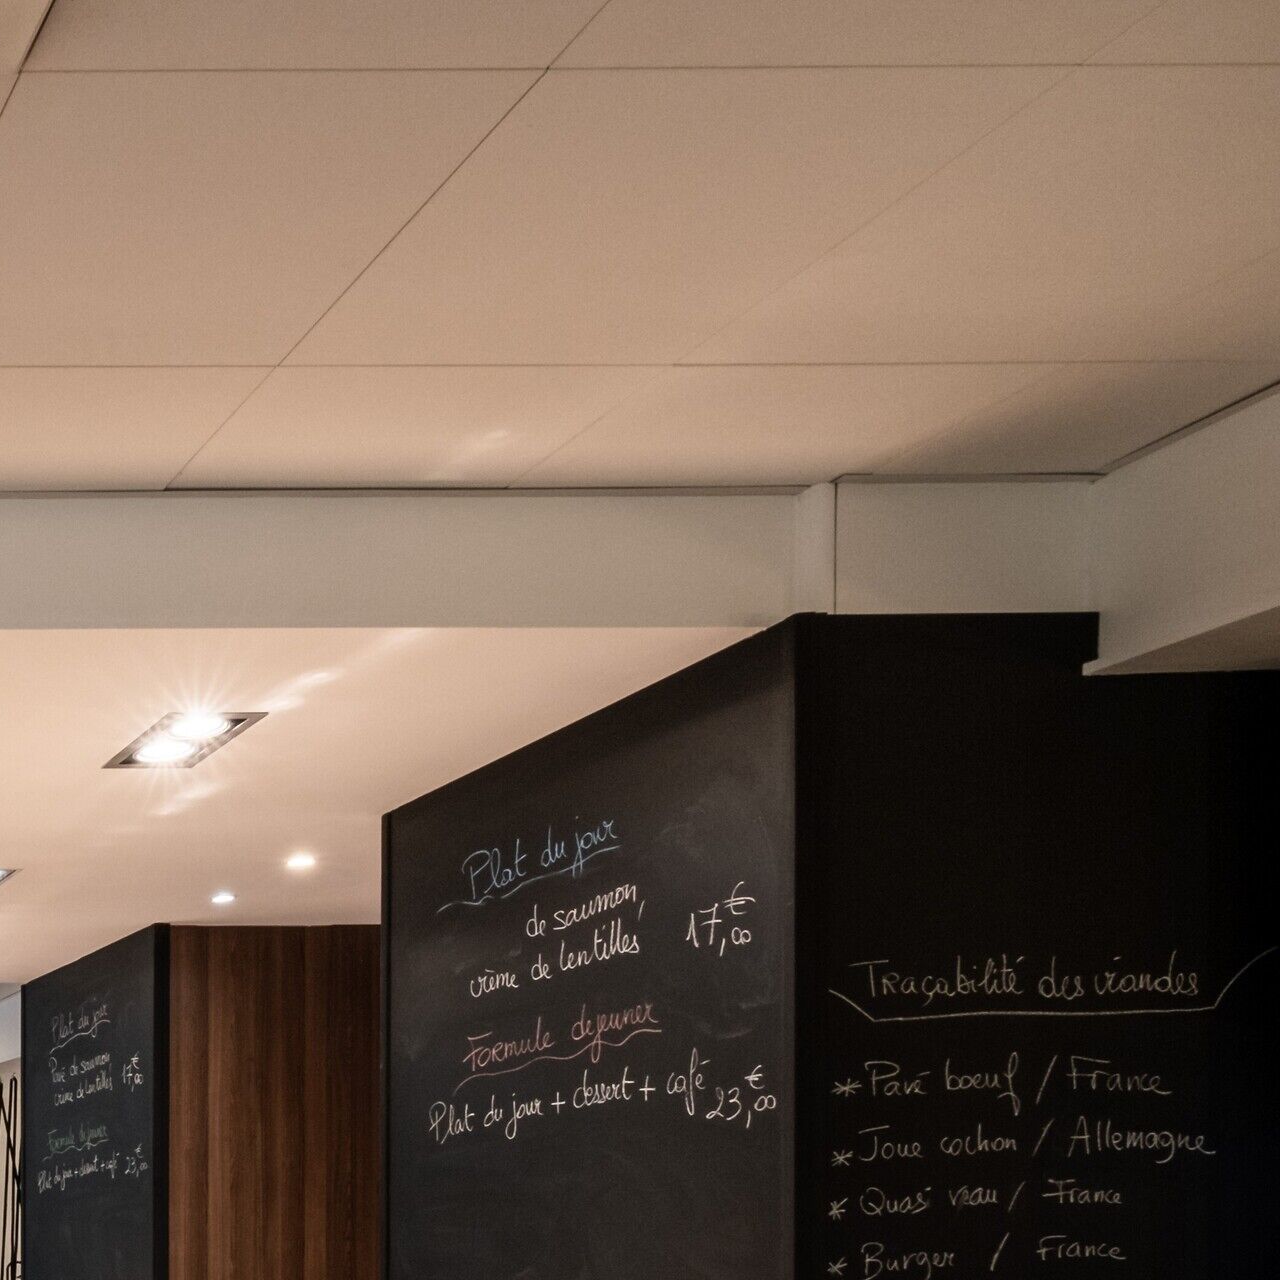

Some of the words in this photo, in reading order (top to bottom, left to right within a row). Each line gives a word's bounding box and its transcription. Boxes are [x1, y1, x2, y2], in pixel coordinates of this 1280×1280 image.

[462, 839, 527, 899] Plat
[540, 825, 567, 868] du
[573, 816, 618, 879] jour
[526, 904, 546, 937] de
[470, 969, 519, 998] crème
[531, 953, 552, 980] de
[559, 917, 640, 971] lentilles
[1039, 956, 1085, 1000] des
[1093, 950, 1199, 997] viandes
[429, 1101, 475, 1144] Plat
[483, 1095, 503, 1127] du
[505, 1093, 545, 1140] jour
[573, 1066, 635, 1109] dessert
[667, 1047, 711, 1116] café
[864, 1060, 930, 1096] Pavé
[1067, 1055, 1172, 1095] France
[858, 1124, 924, 1162] Joue
[939, 1123, 1018, 1157] cochon
[1067, 1115, 1216, 1164] Allemagne
[859, 1186, 931, 1216] Quasi
[948, 1183, 998, 1208] veau
[1043, 1179, 1123, 1205] France
[1036, 1235, 1127, 1261] France
